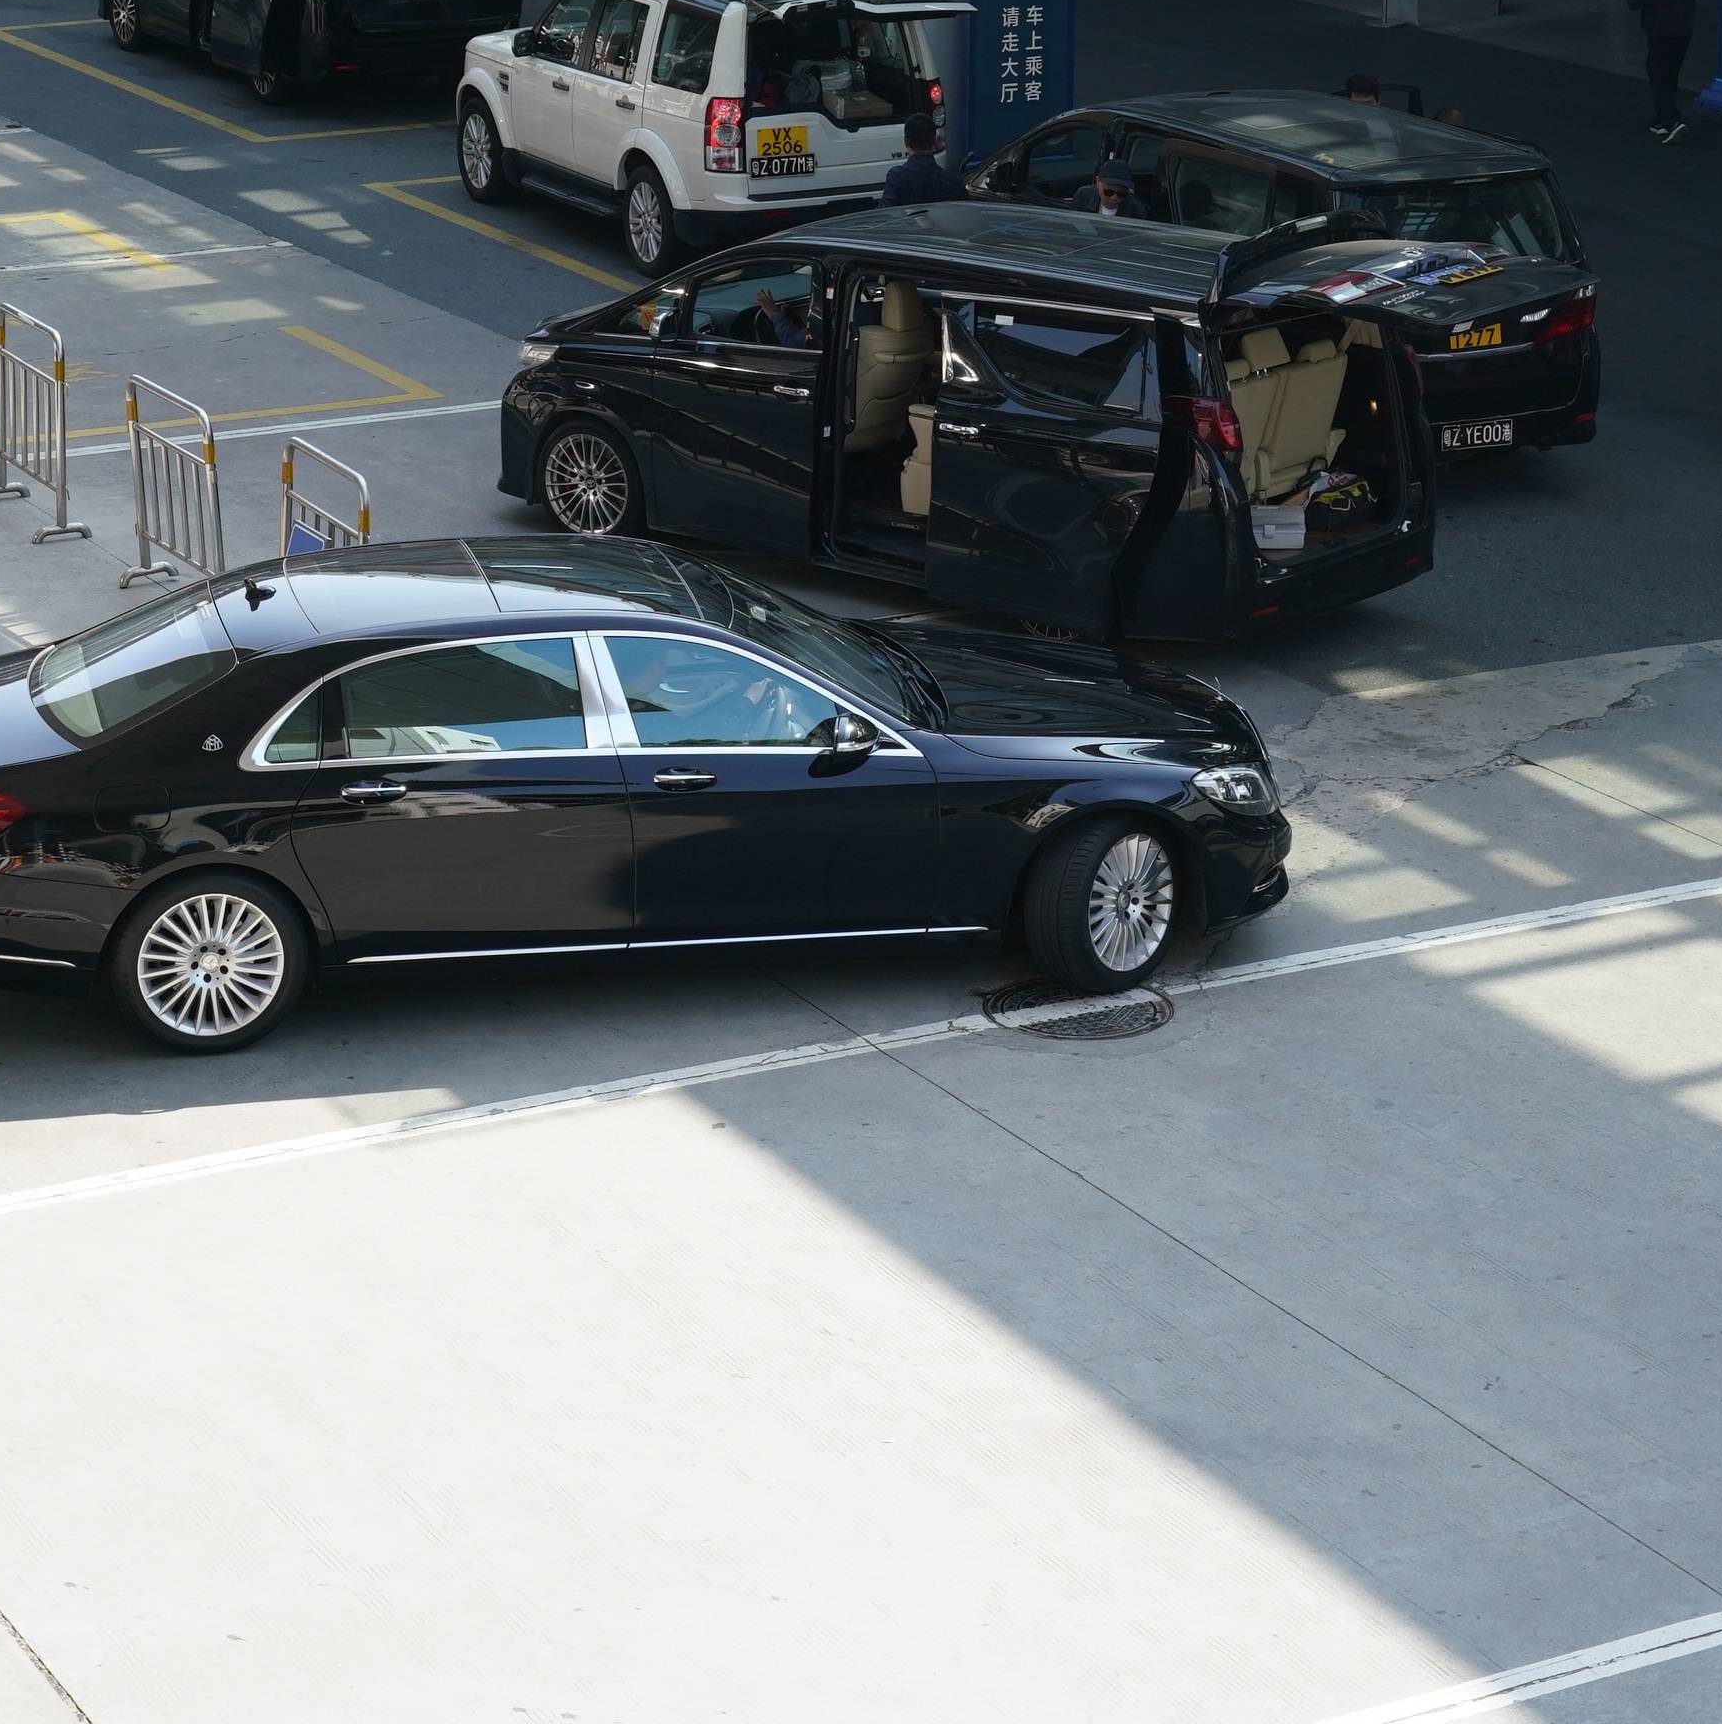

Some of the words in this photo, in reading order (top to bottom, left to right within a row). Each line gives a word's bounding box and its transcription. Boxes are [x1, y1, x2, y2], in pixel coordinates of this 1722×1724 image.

[1000, 6, 1020, 104] 请走大厅
[1025, 5, 1044, 102] 车上乘客
[762, 140, 803, 156] 2506
[772, 127, 792, 141] VX
